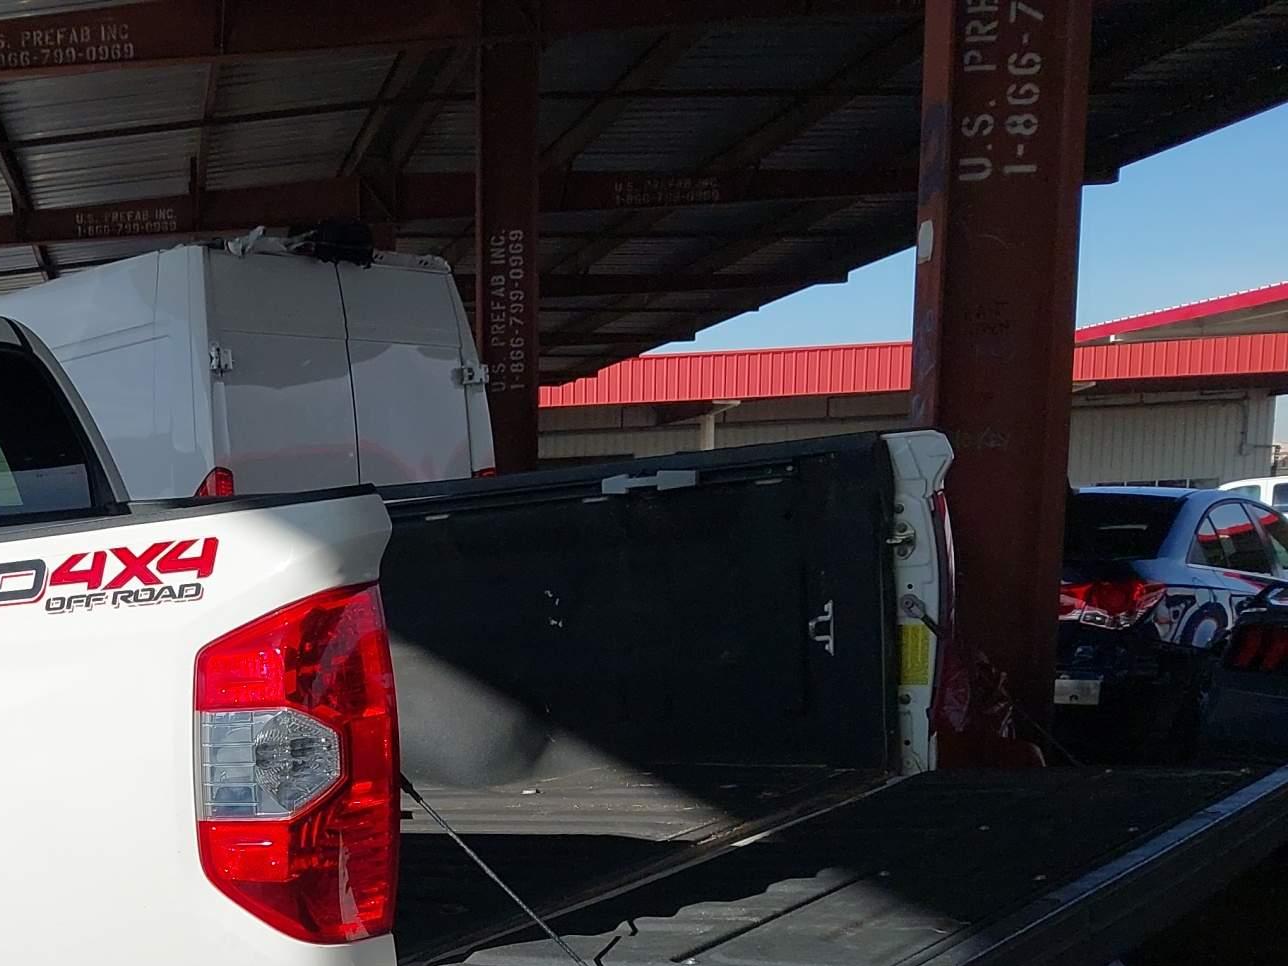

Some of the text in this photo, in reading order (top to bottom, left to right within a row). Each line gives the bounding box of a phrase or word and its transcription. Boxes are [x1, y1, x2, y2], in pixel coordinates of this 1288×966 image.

[21, 25, 91, 48] PREFAB
[958, 99, 997, 181] U.S.
[489, 229, 506, 265] INC.
[489, 275, 506, 347] PREFAB
[508, 229, 526, 391] 1-866-799-0969
[45, 582, 205, 615] OFF ROAD
